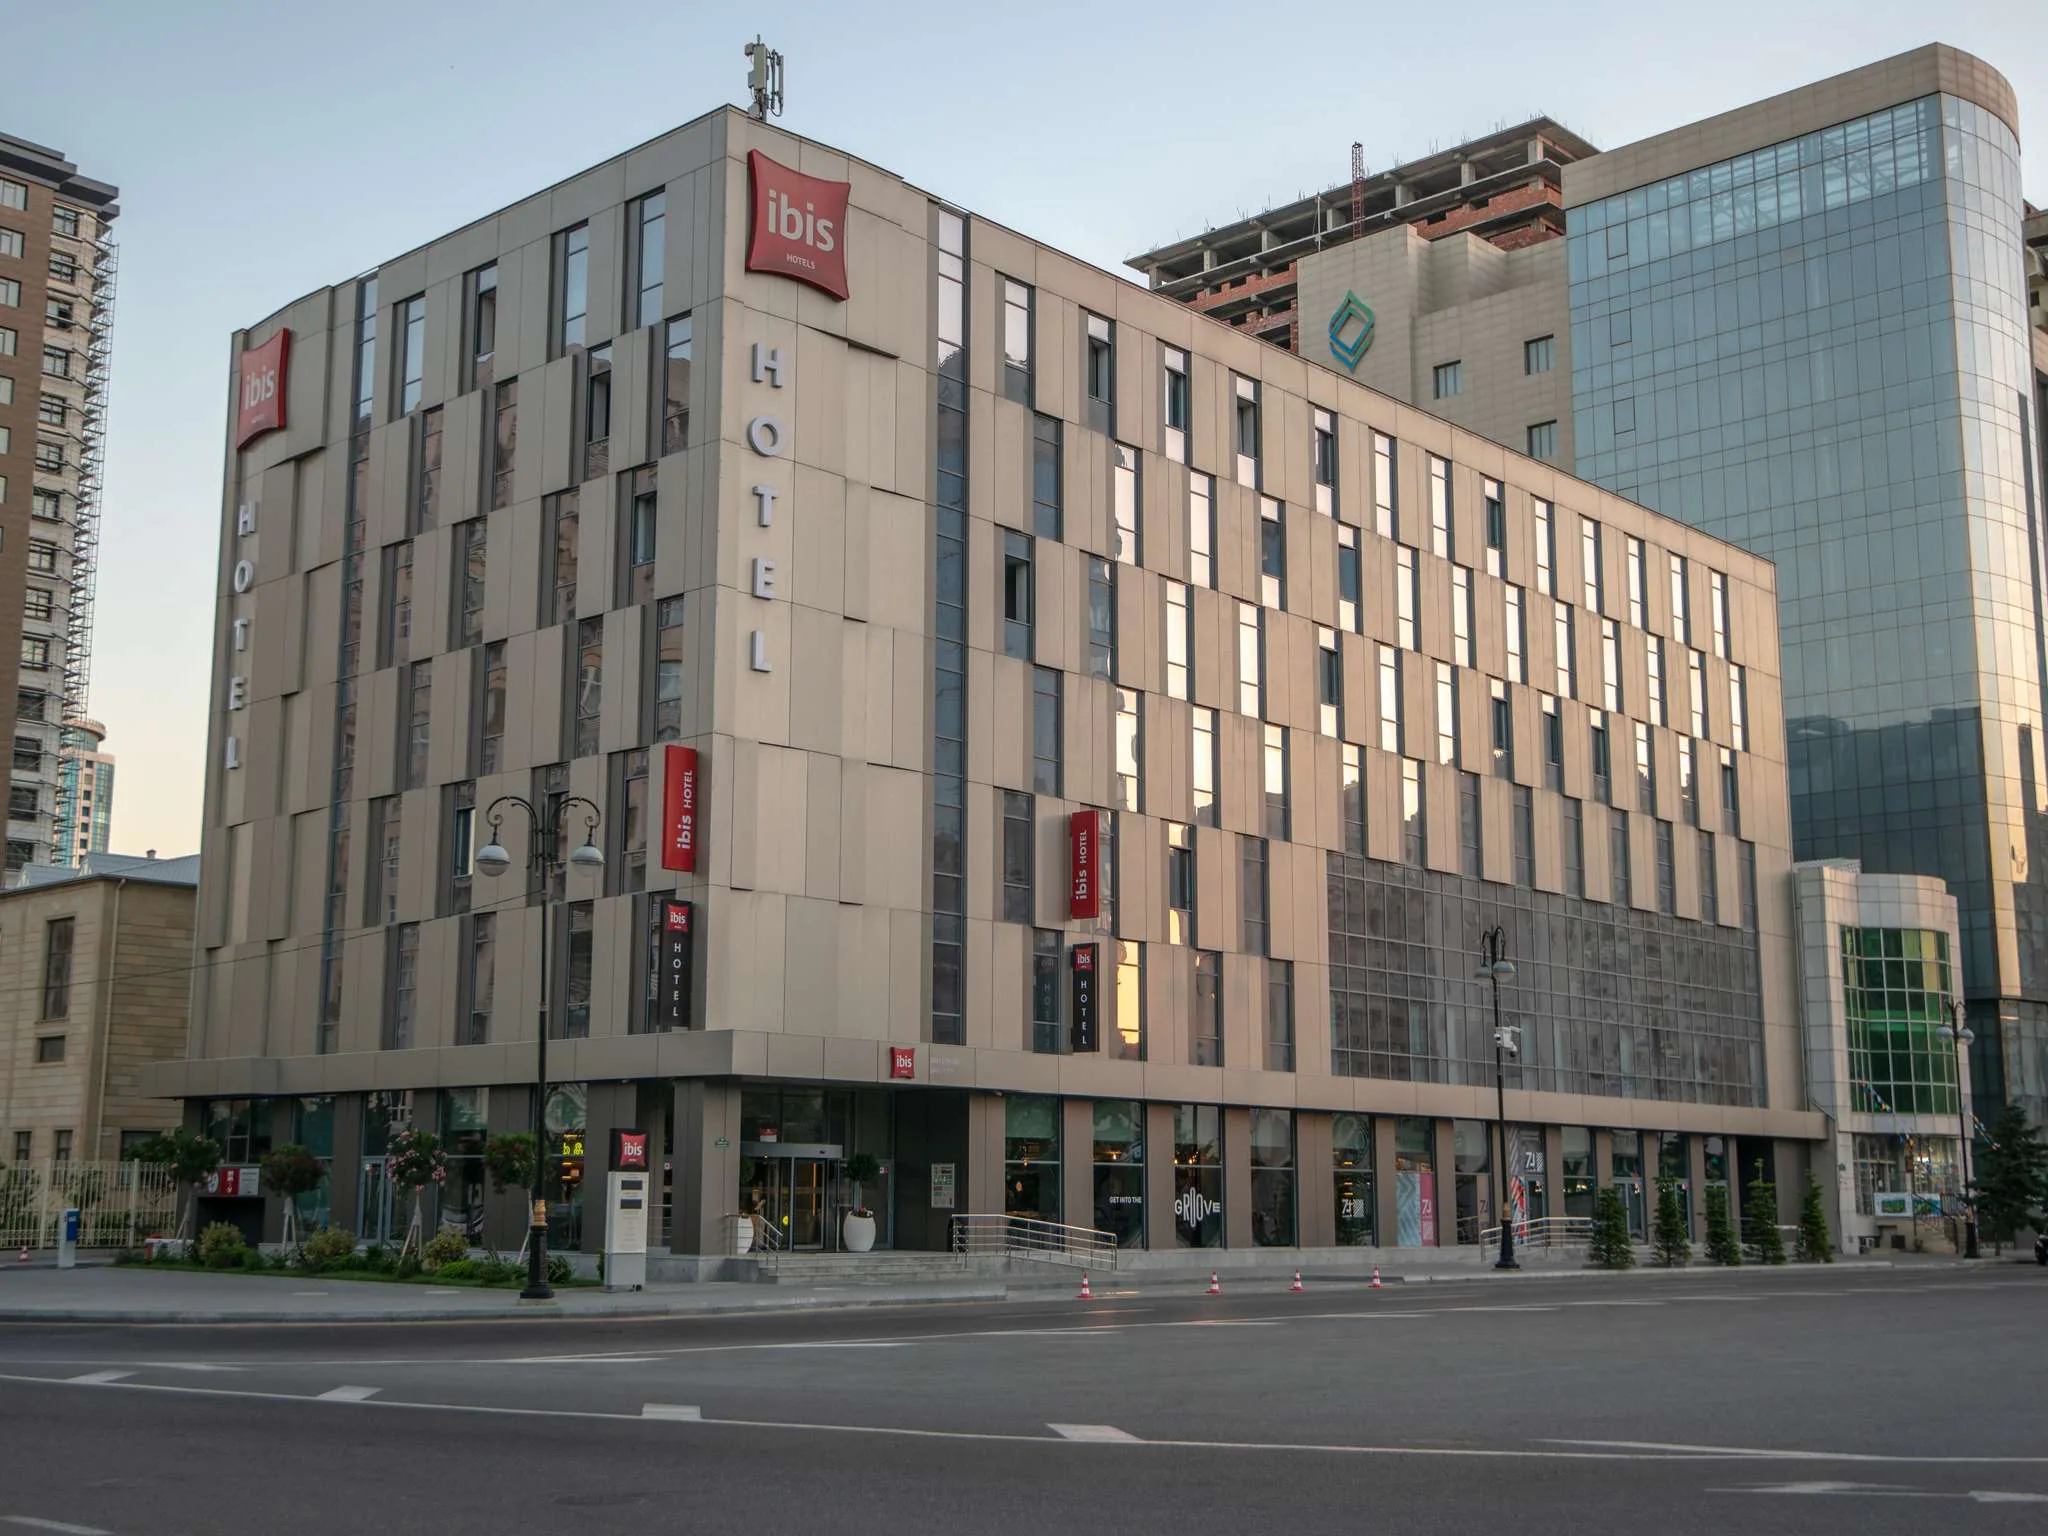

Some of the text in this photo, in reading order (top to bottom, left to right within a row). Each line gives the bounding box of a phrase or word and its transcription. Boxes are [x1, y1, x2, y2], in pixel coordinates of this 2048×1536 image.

[768, 189, 834, 251] ibis
[786, 253, 816, 270] HOTELS
[245, 365, 275, 410] ibis
[748, 341, 784, 673] HOTEL
[226, 501, 257, 770] HOTEL
[677, 769, 693, 849] ibis HOTEL
[1075, 829, 1087, 899] ibis HOTEL
[670, 911, 686, 924] ibis
[673, 942, 682, 1017] HOTEL
[1077, 954, 1090, 964] ibis
[1080, 980, 1088, 1045] HOTEL
[896, 1054, 912, 1068] ibis
[624, 1142, 643, 1156] ibis
[1109, 1196, 1119, 1204] GET
[1174, 1187, 1221, 1228] GROOVE
